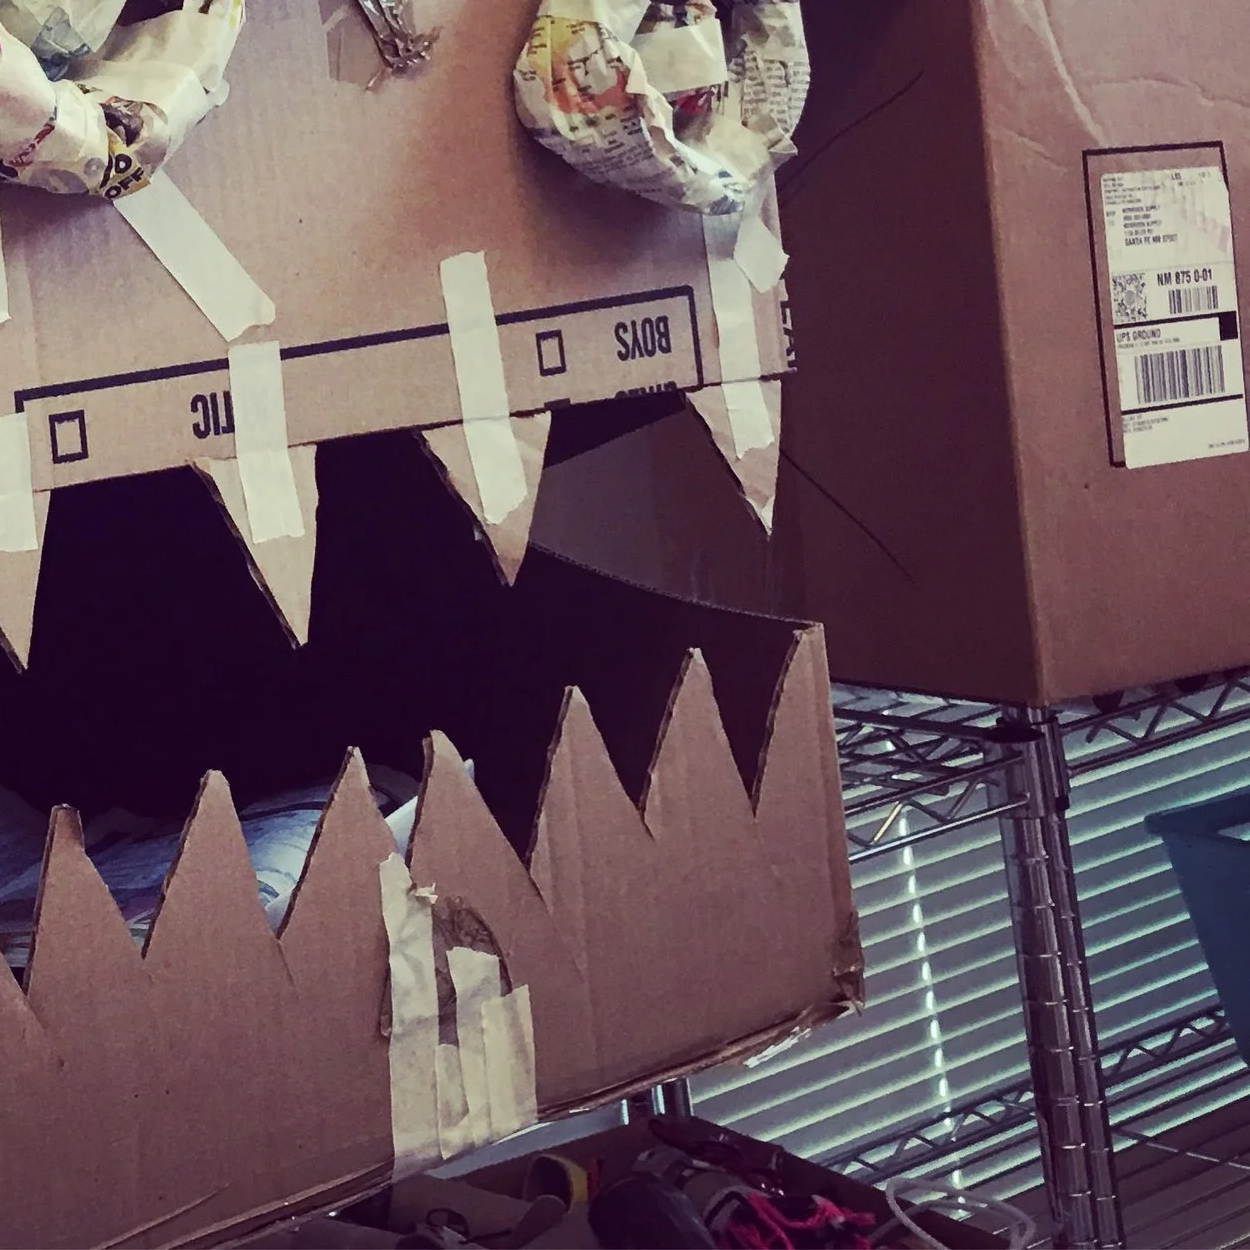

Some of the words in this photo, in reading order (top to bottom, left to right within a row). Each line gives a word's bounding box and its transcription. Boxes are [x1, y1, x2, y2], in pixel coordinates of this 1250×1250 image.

[104, 166, 144, 200] OFF
[1156, 271, 1172, 287] NM
[1174, 270, 1191, 286] 875
[614, 315, 672, 362] BOYS
[190, 390, 235, 440] TIC
